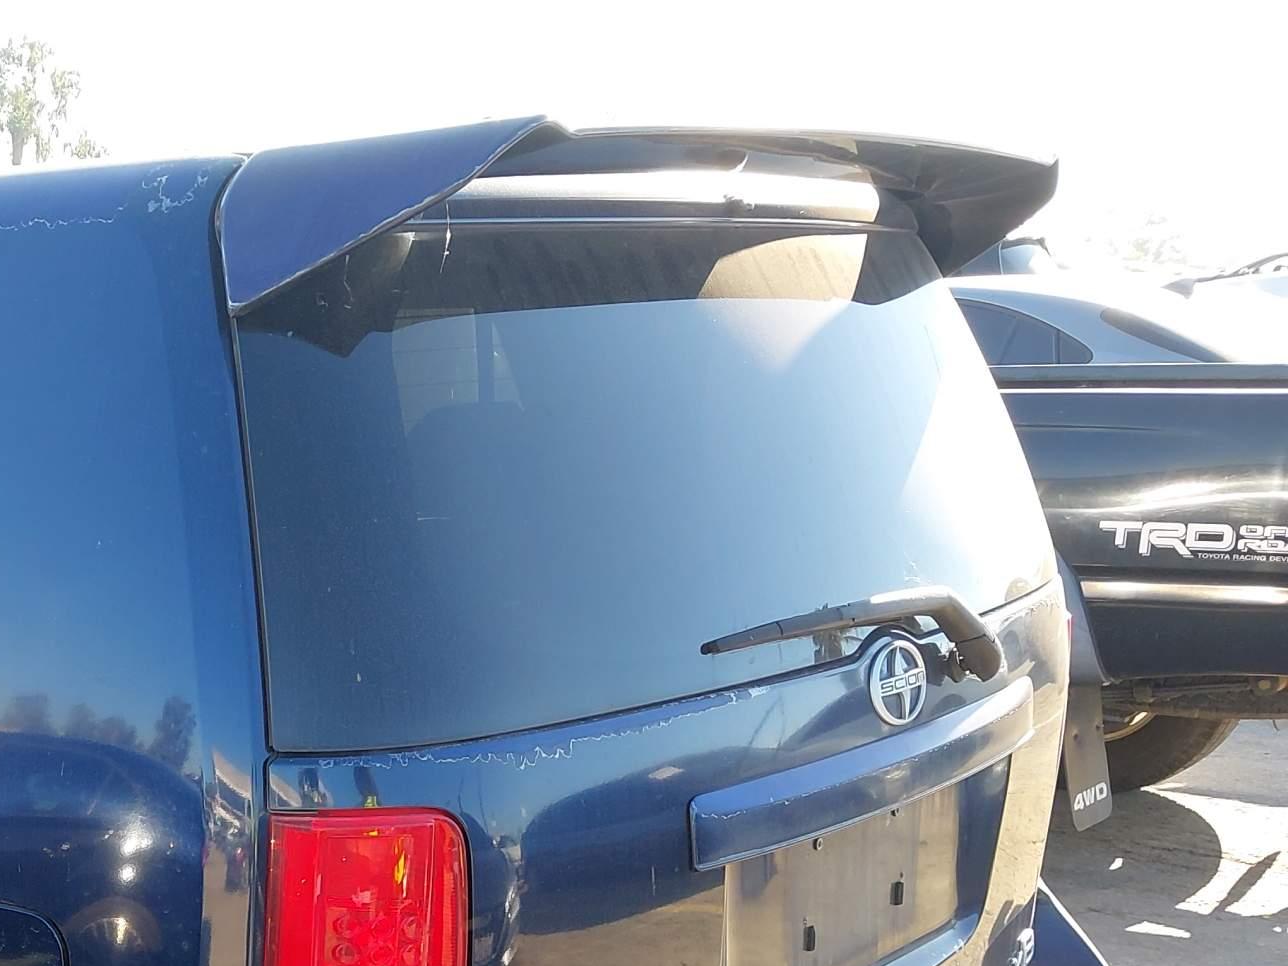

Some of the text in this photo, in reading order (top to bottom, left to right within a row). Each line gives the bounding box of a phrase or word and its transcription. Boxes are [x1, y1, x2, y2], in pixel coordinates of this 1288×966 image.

[1099, 520, 1236, 557] TRD
[1239, 525, 1288, 539] OF
[1197, 552, 1231, 560] TOYOTA
[880, 670, 925, 695] SCION
[1073, 782, 1108, 811] 4WD
